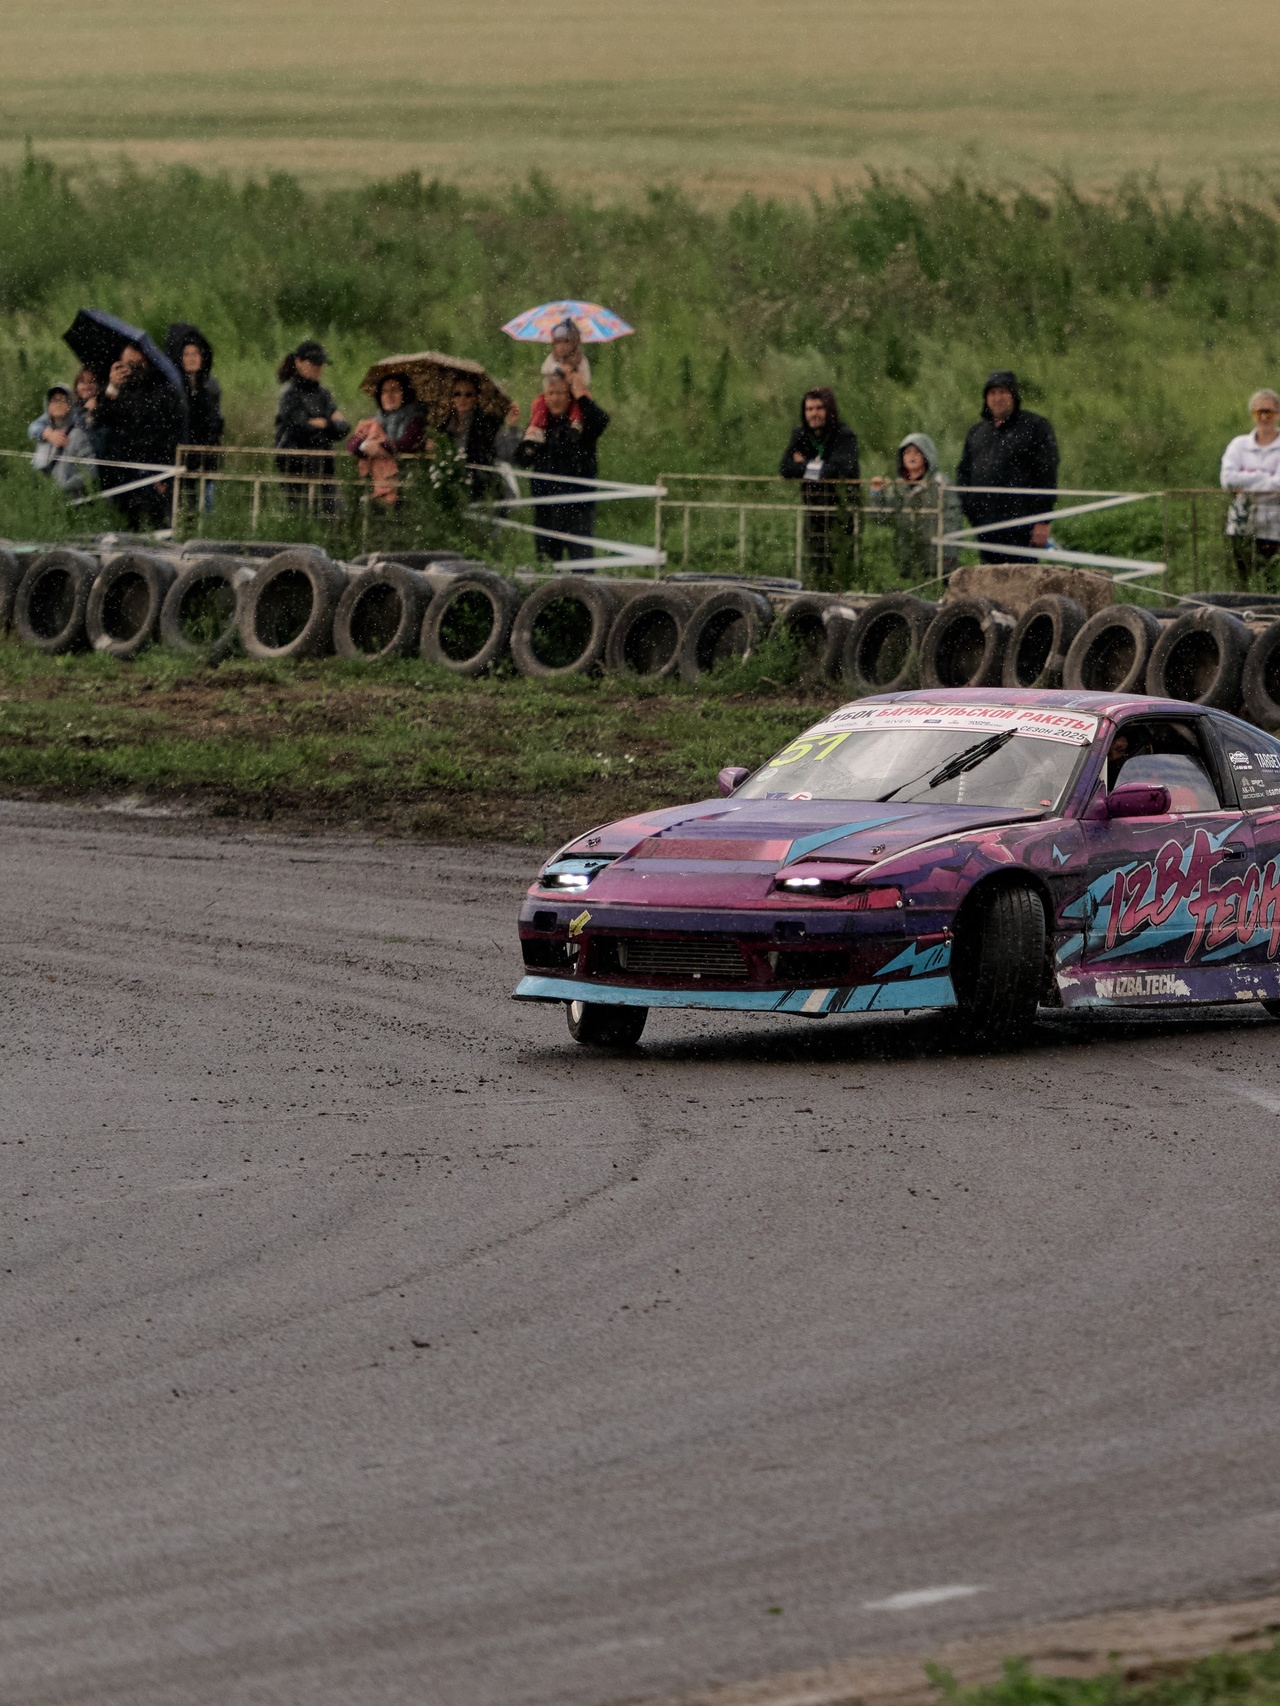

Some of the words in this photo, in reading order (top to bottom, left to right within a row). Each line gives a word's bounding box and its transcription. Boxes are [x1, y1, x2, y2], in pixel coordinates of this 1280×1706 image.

[820, 710, 878, 724] КУБОК
[876, 707, 1018, 719] БАРНАУЛЬСКОЙ
[1016, 711, 1095, 731] РАКЕТЫ
[1019, 725, 1053, 734] СЕЗОН
[1053, 729, 1089, 740] 2025
[769, 732, 853, 767] 51
